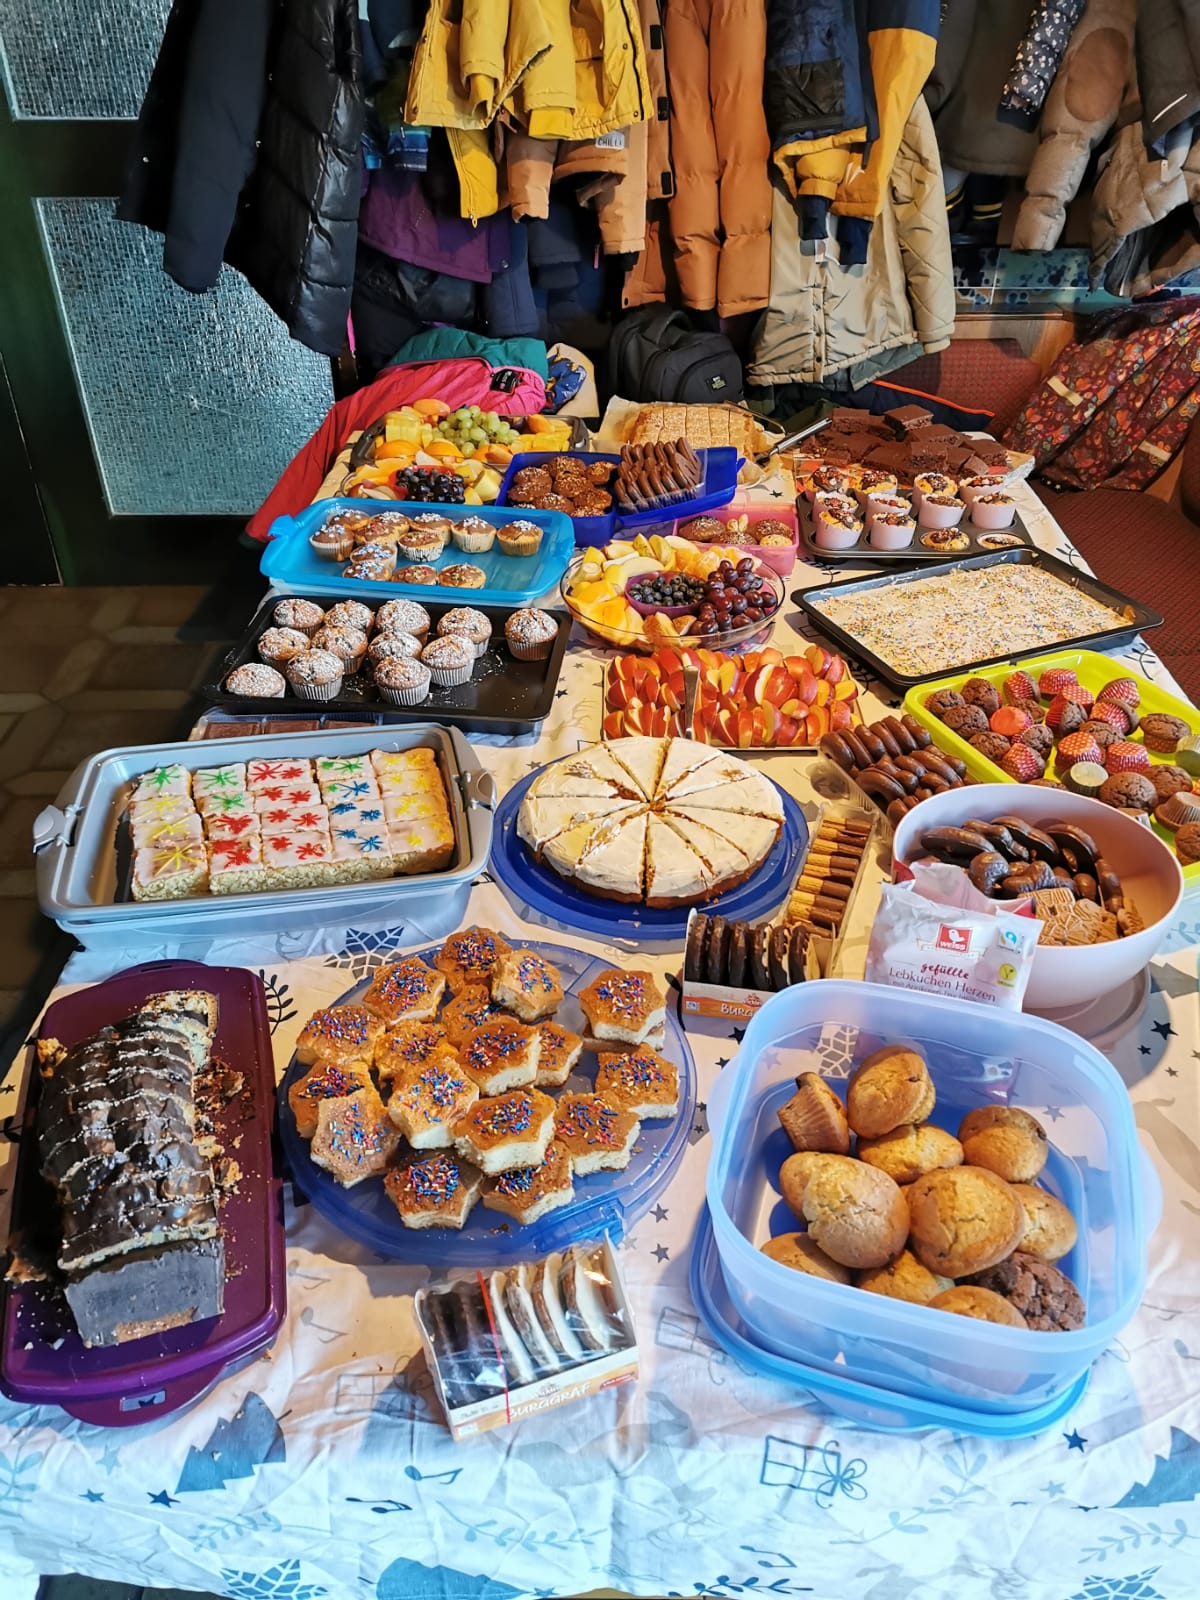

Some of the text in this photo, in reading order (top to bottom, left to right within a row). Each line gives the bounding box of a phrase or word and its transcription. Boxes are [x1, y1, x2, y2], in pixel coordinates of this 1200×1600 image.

[940, 941, 966, 950] weiss
[921, 963, 969, 979] gefüllte
[889, 967, 951, 989] Lebkuchen
[956, 980, 996, 1002] Herzen
